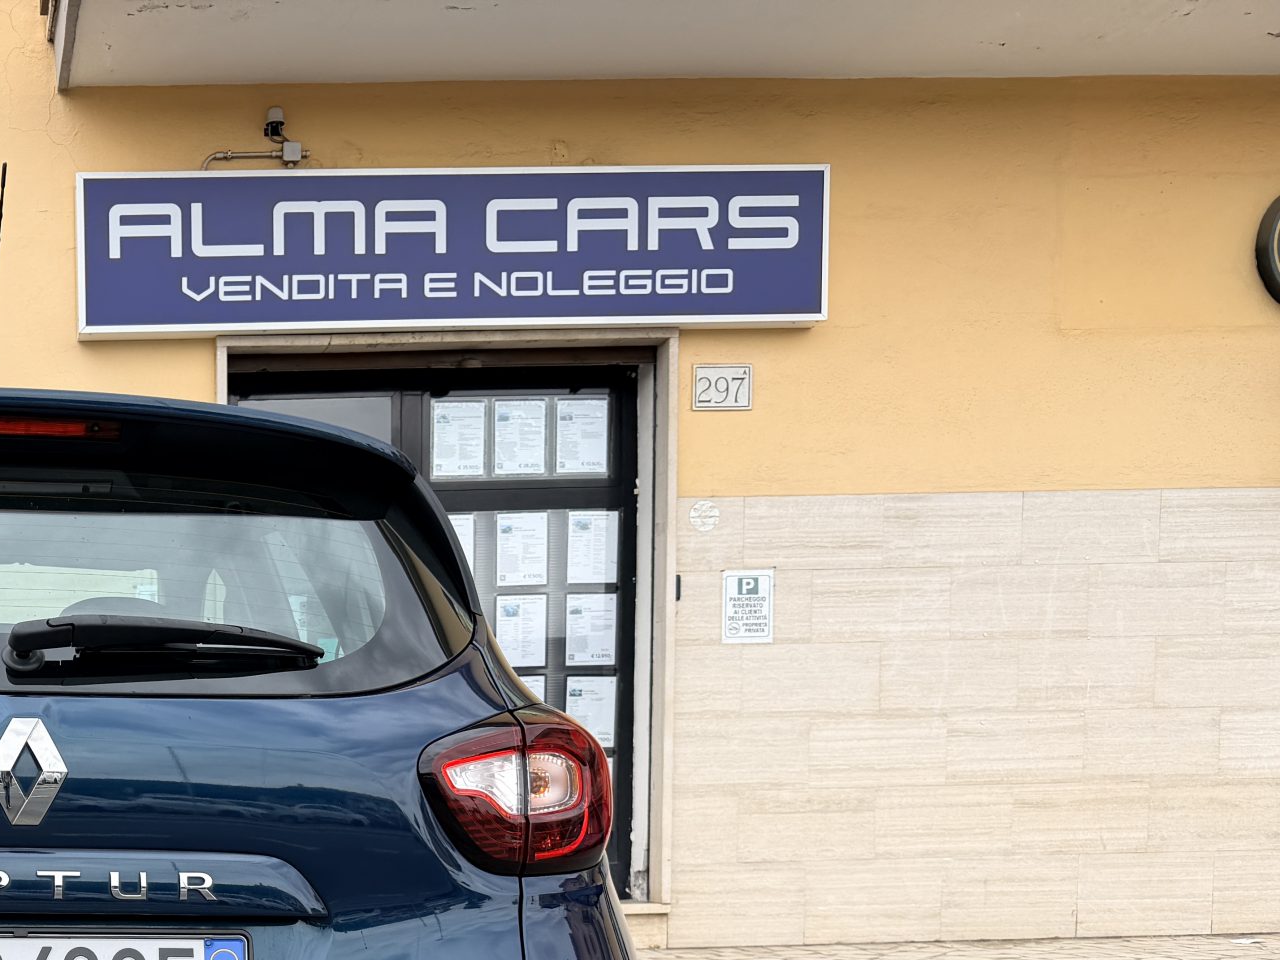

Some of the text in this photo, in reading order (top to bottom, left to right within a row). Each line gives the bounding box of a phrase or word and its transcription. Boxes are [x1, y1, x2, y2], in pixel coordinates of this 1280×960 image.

[108, 195, 800, 259] ALMA CARS
[181, 267, 734, 302] VENDITA E NOLEGGIO
[697, 376, 747, 404] 297
[742, 578, 755, 594] P
